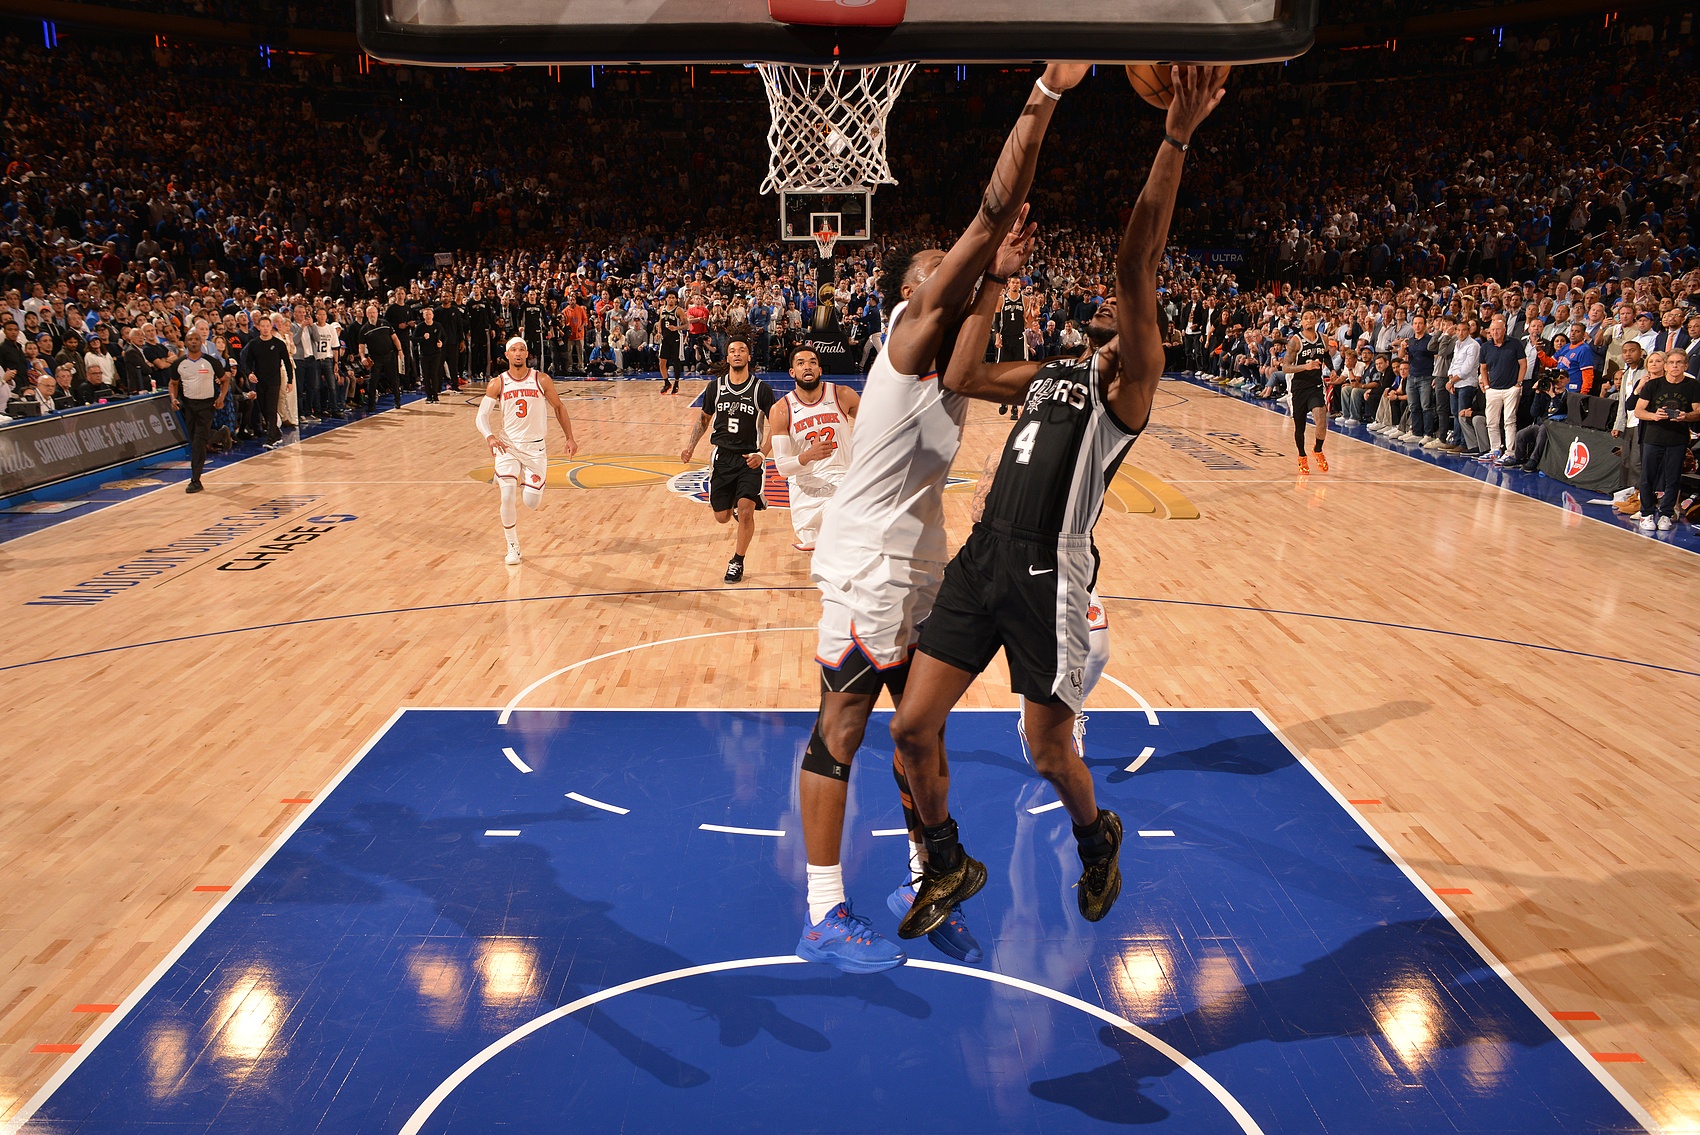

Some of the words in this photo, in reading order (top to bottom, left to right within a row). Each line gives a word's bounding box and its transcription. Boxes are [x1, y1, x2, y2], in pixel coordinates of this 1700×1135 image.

[1211, 253, 1244, 262] ULTRA
[1010, 312, 1015, 321] 1
[813, 341, 846, 354] Finals
[503, 389, 519, 401] NEW
[519, 388, 540, 399] YORK
[1025, 377, 1089, 414] PURS
[515, 398, 528, 418] 3
[717, 402, 755, 416] SPURS
[727, 417, 740, 434] 5
[793, 416, 815, 434] NEW
[813, 412, 840, 426] YORK
[33, 431, 83, 465] SATURDAY
[78, 426, 109, 453] GAME
[102, 425, 114, 447] 5
[1012, 420, 1041, 465] 4
[216, 525, 338, 572] CHASE
[22, 556, 194, 606] MADISON
[144, 522, 267, 554] SQUARE
